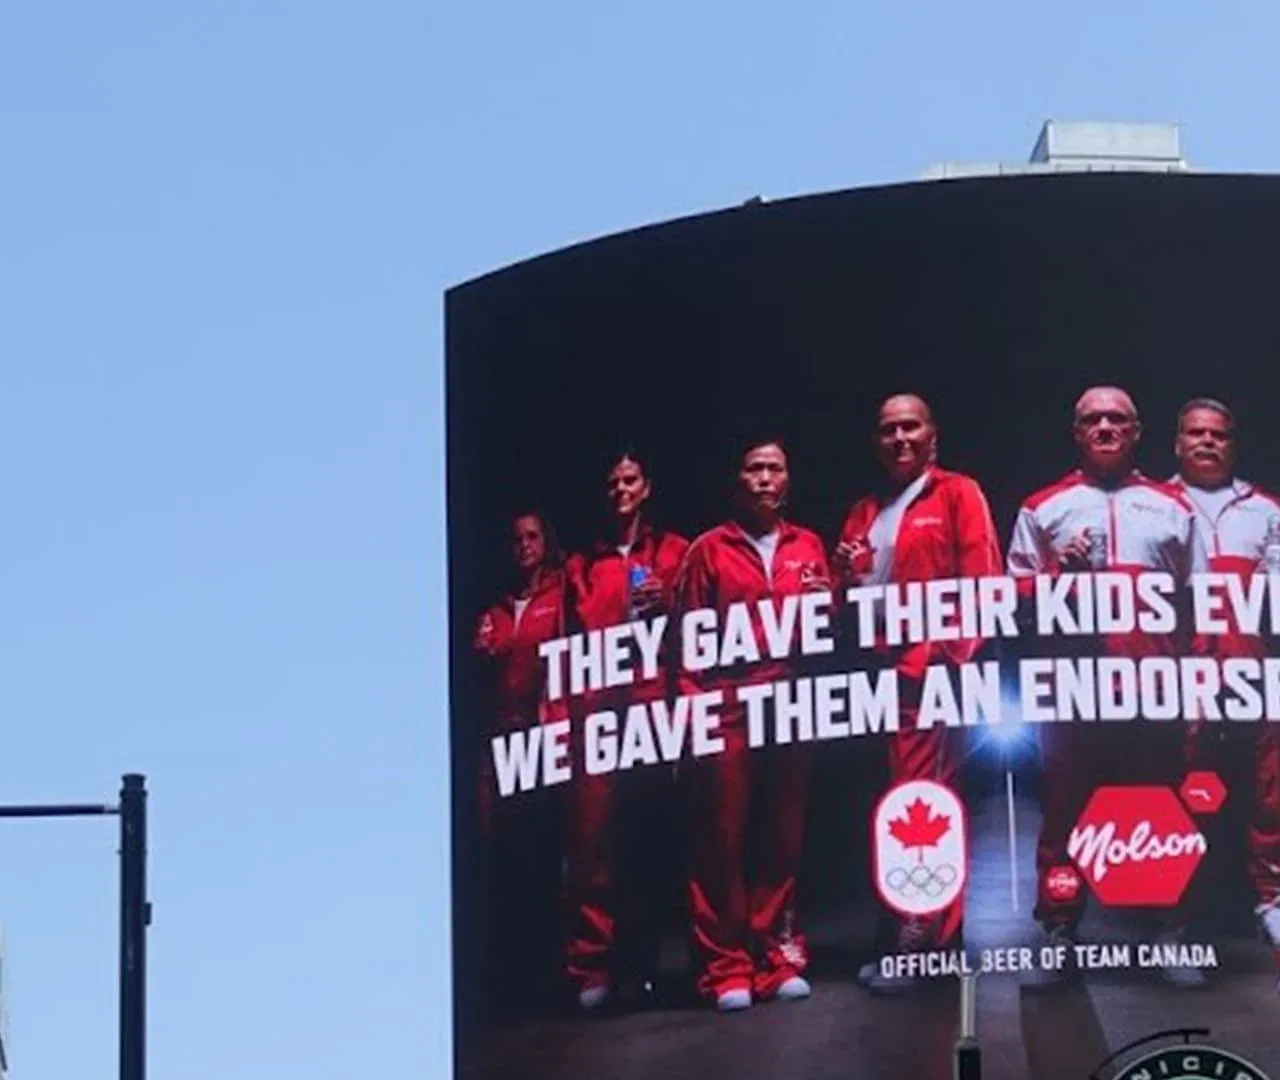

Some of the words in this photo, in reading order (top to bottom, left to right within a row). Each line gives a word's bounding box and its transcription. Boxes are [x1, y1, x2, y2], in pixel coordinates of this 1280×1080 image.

[539, 615, 667, 701] THEY
[681, 591, 835, 674] GAVE
[848, 576, 1018, 649] THEIR
[1036, 572, 1177, 636] KIDS
[492, 718, 572, 798] WE
[584, 692, 725, 776] GAVE
[738, 670, 901, 748] THEM
[917, 659, 1010, 730] AN
[1067, 820, 1207, 883] Molson
[880, 949, 972, 979] OFFICIAL
[981, 947, 1033, 973] BEER
[1040, 947, 1067, 970] OF
[1075, 945, 1130, 969] TEAM
[1138, 943, 1220, 969] CANADA
